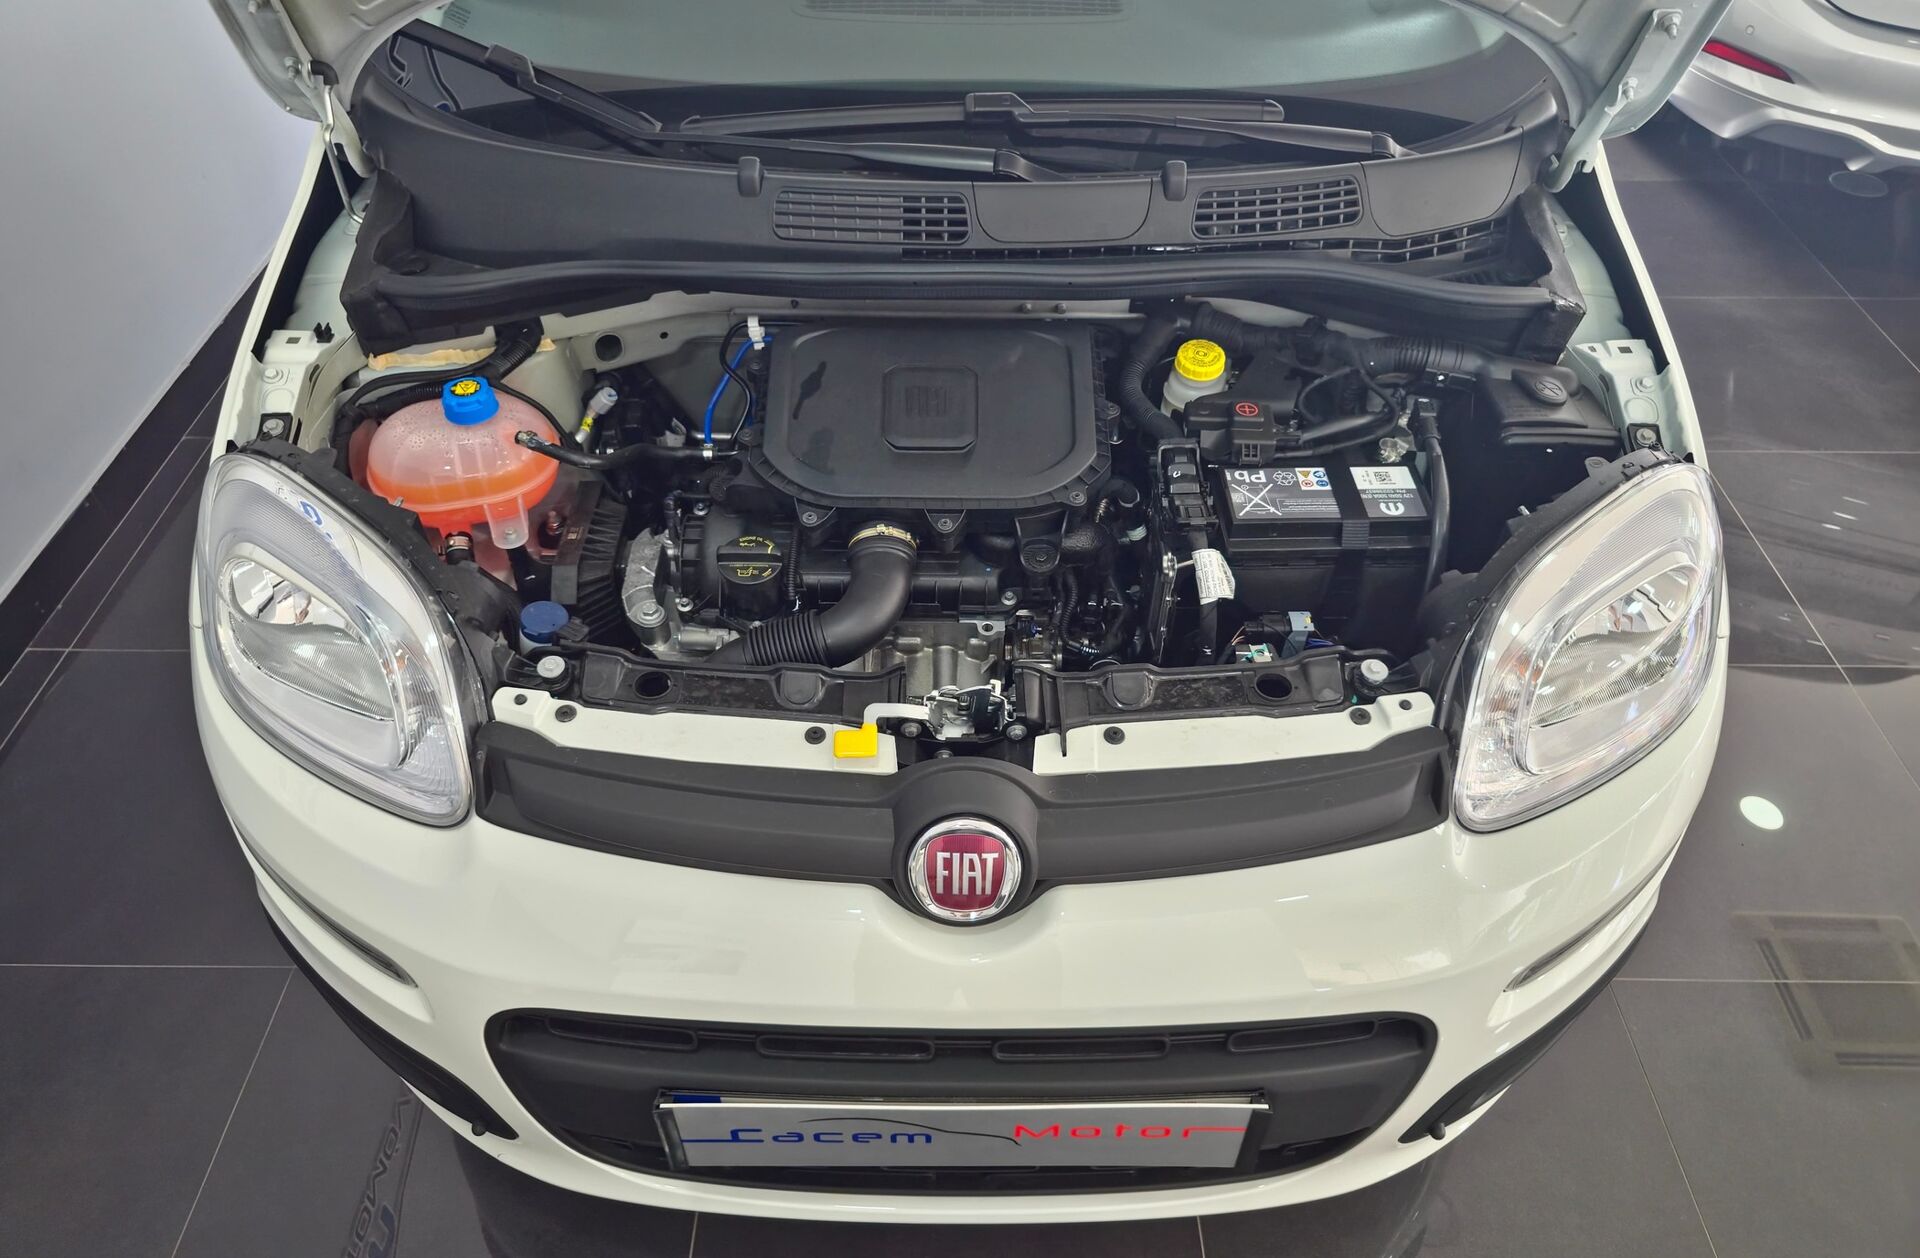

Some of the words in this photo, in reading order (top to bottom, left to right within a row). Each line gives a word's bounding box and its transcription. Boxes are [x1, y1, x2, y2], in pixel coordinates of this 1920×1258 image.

[1234, 470, 1267, 483] Pb
[935, 851, 999, 895] FIAT
[681, 1128, 933, 1143] Cacem
[1013, 1123, 1248, 1140] Motor
